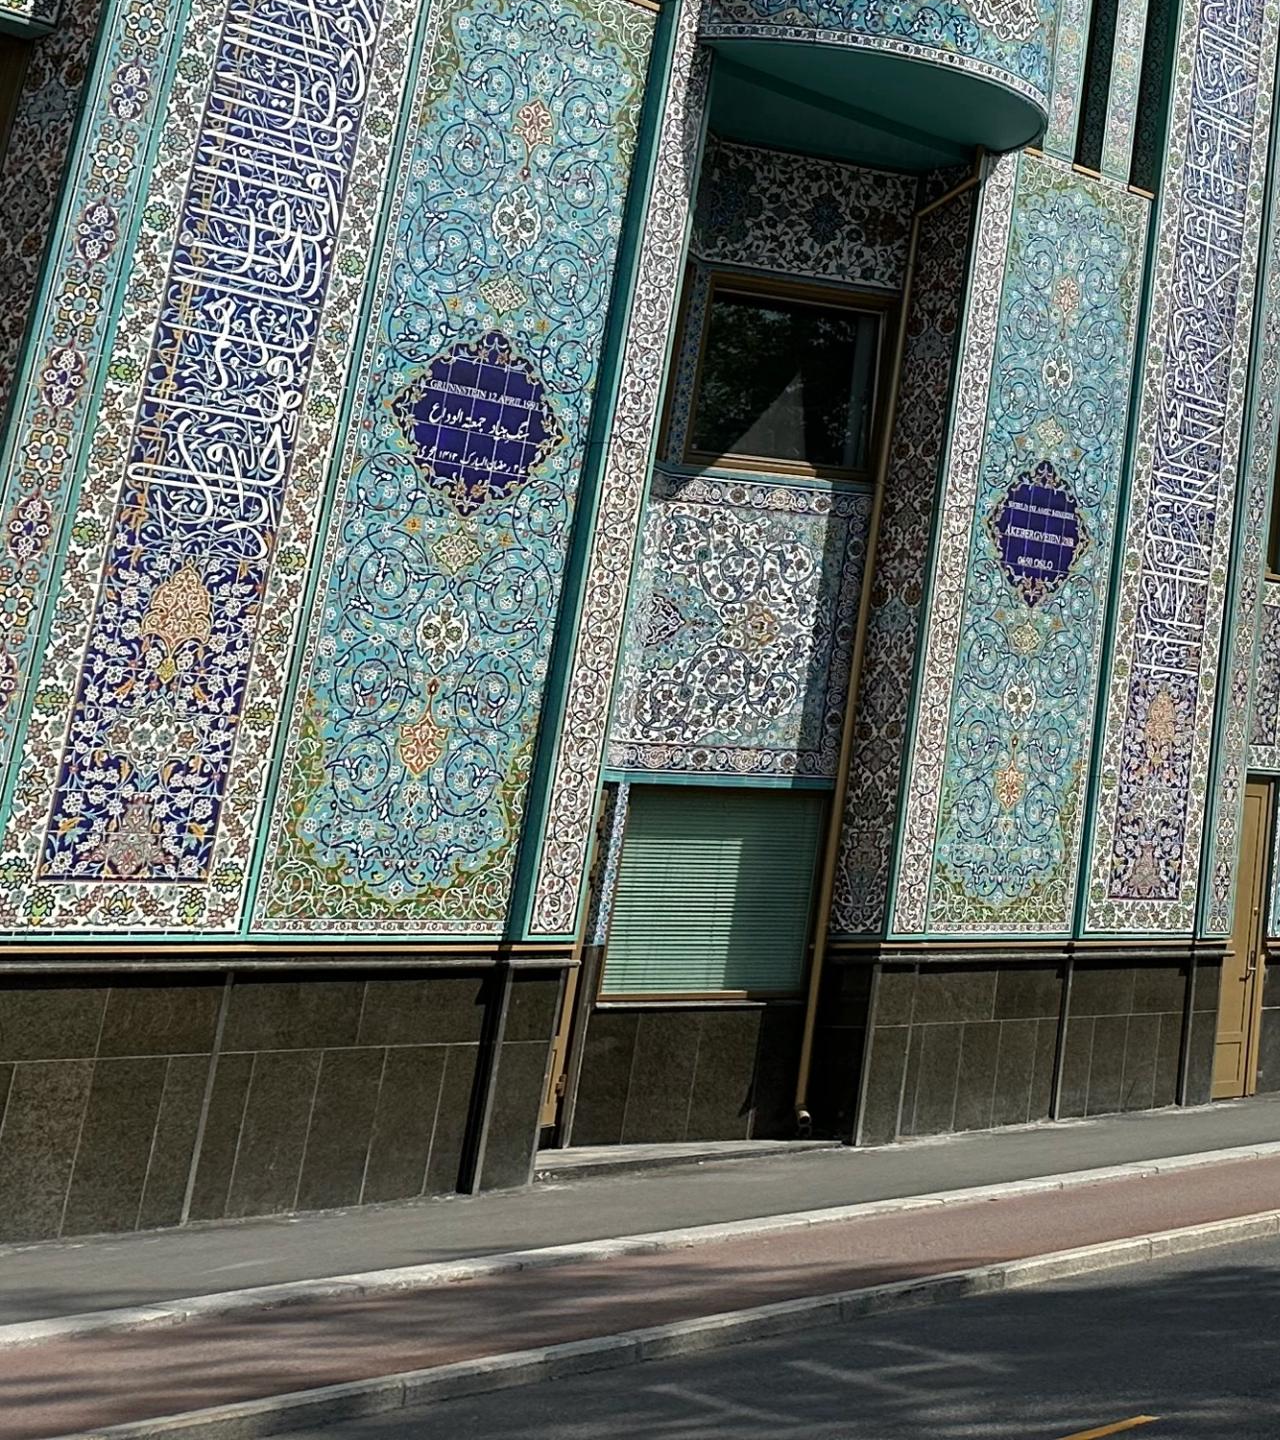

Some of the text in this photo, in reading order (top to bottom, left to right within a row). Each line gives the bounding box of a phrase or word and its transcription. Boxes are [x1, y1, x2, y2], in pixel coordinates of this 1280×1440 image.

[430, 379, 487, 399] GRUNNSTEIN
[488, 392, 497, 402] 12
[498, 394, 522, 407] APRIL
